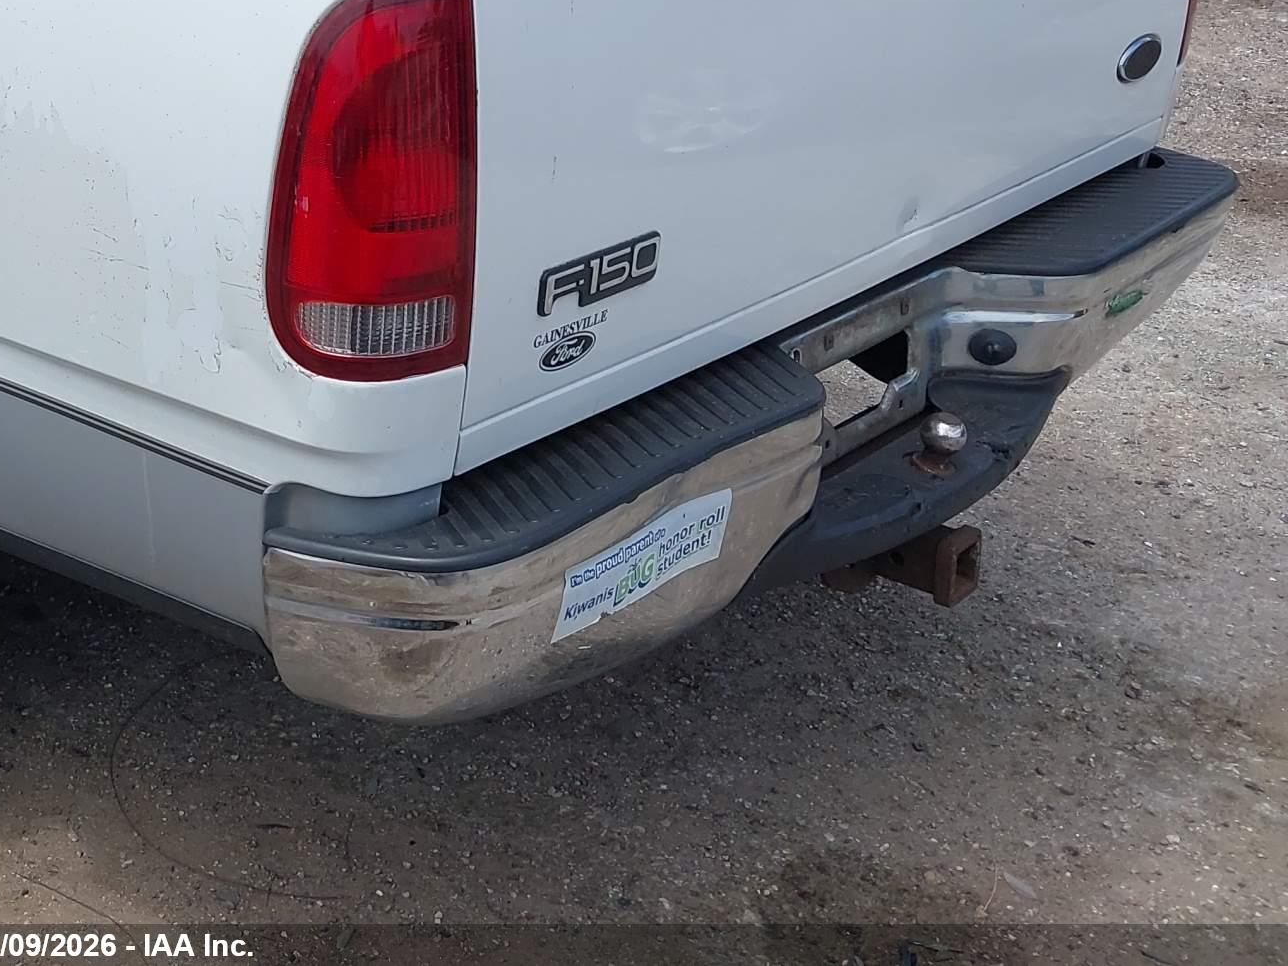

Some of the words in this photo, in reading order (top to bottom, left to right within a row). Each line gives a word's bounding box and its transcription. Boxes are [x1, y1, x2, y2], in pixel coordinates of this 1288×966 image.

[533, 308, 609, 349] GAINESVILLE
[583, 567, 596, 582] the
[596, 546, 624, 579] proud
[624, 531, 655, 563] parent
[657, 530, 712, 577] student!
[658, 523, 696, 558] honor
[699, 506, 725, 535] roll
[564, 586, 615, 621] Kiwanis
[614, 553, 655, 607] BUG
